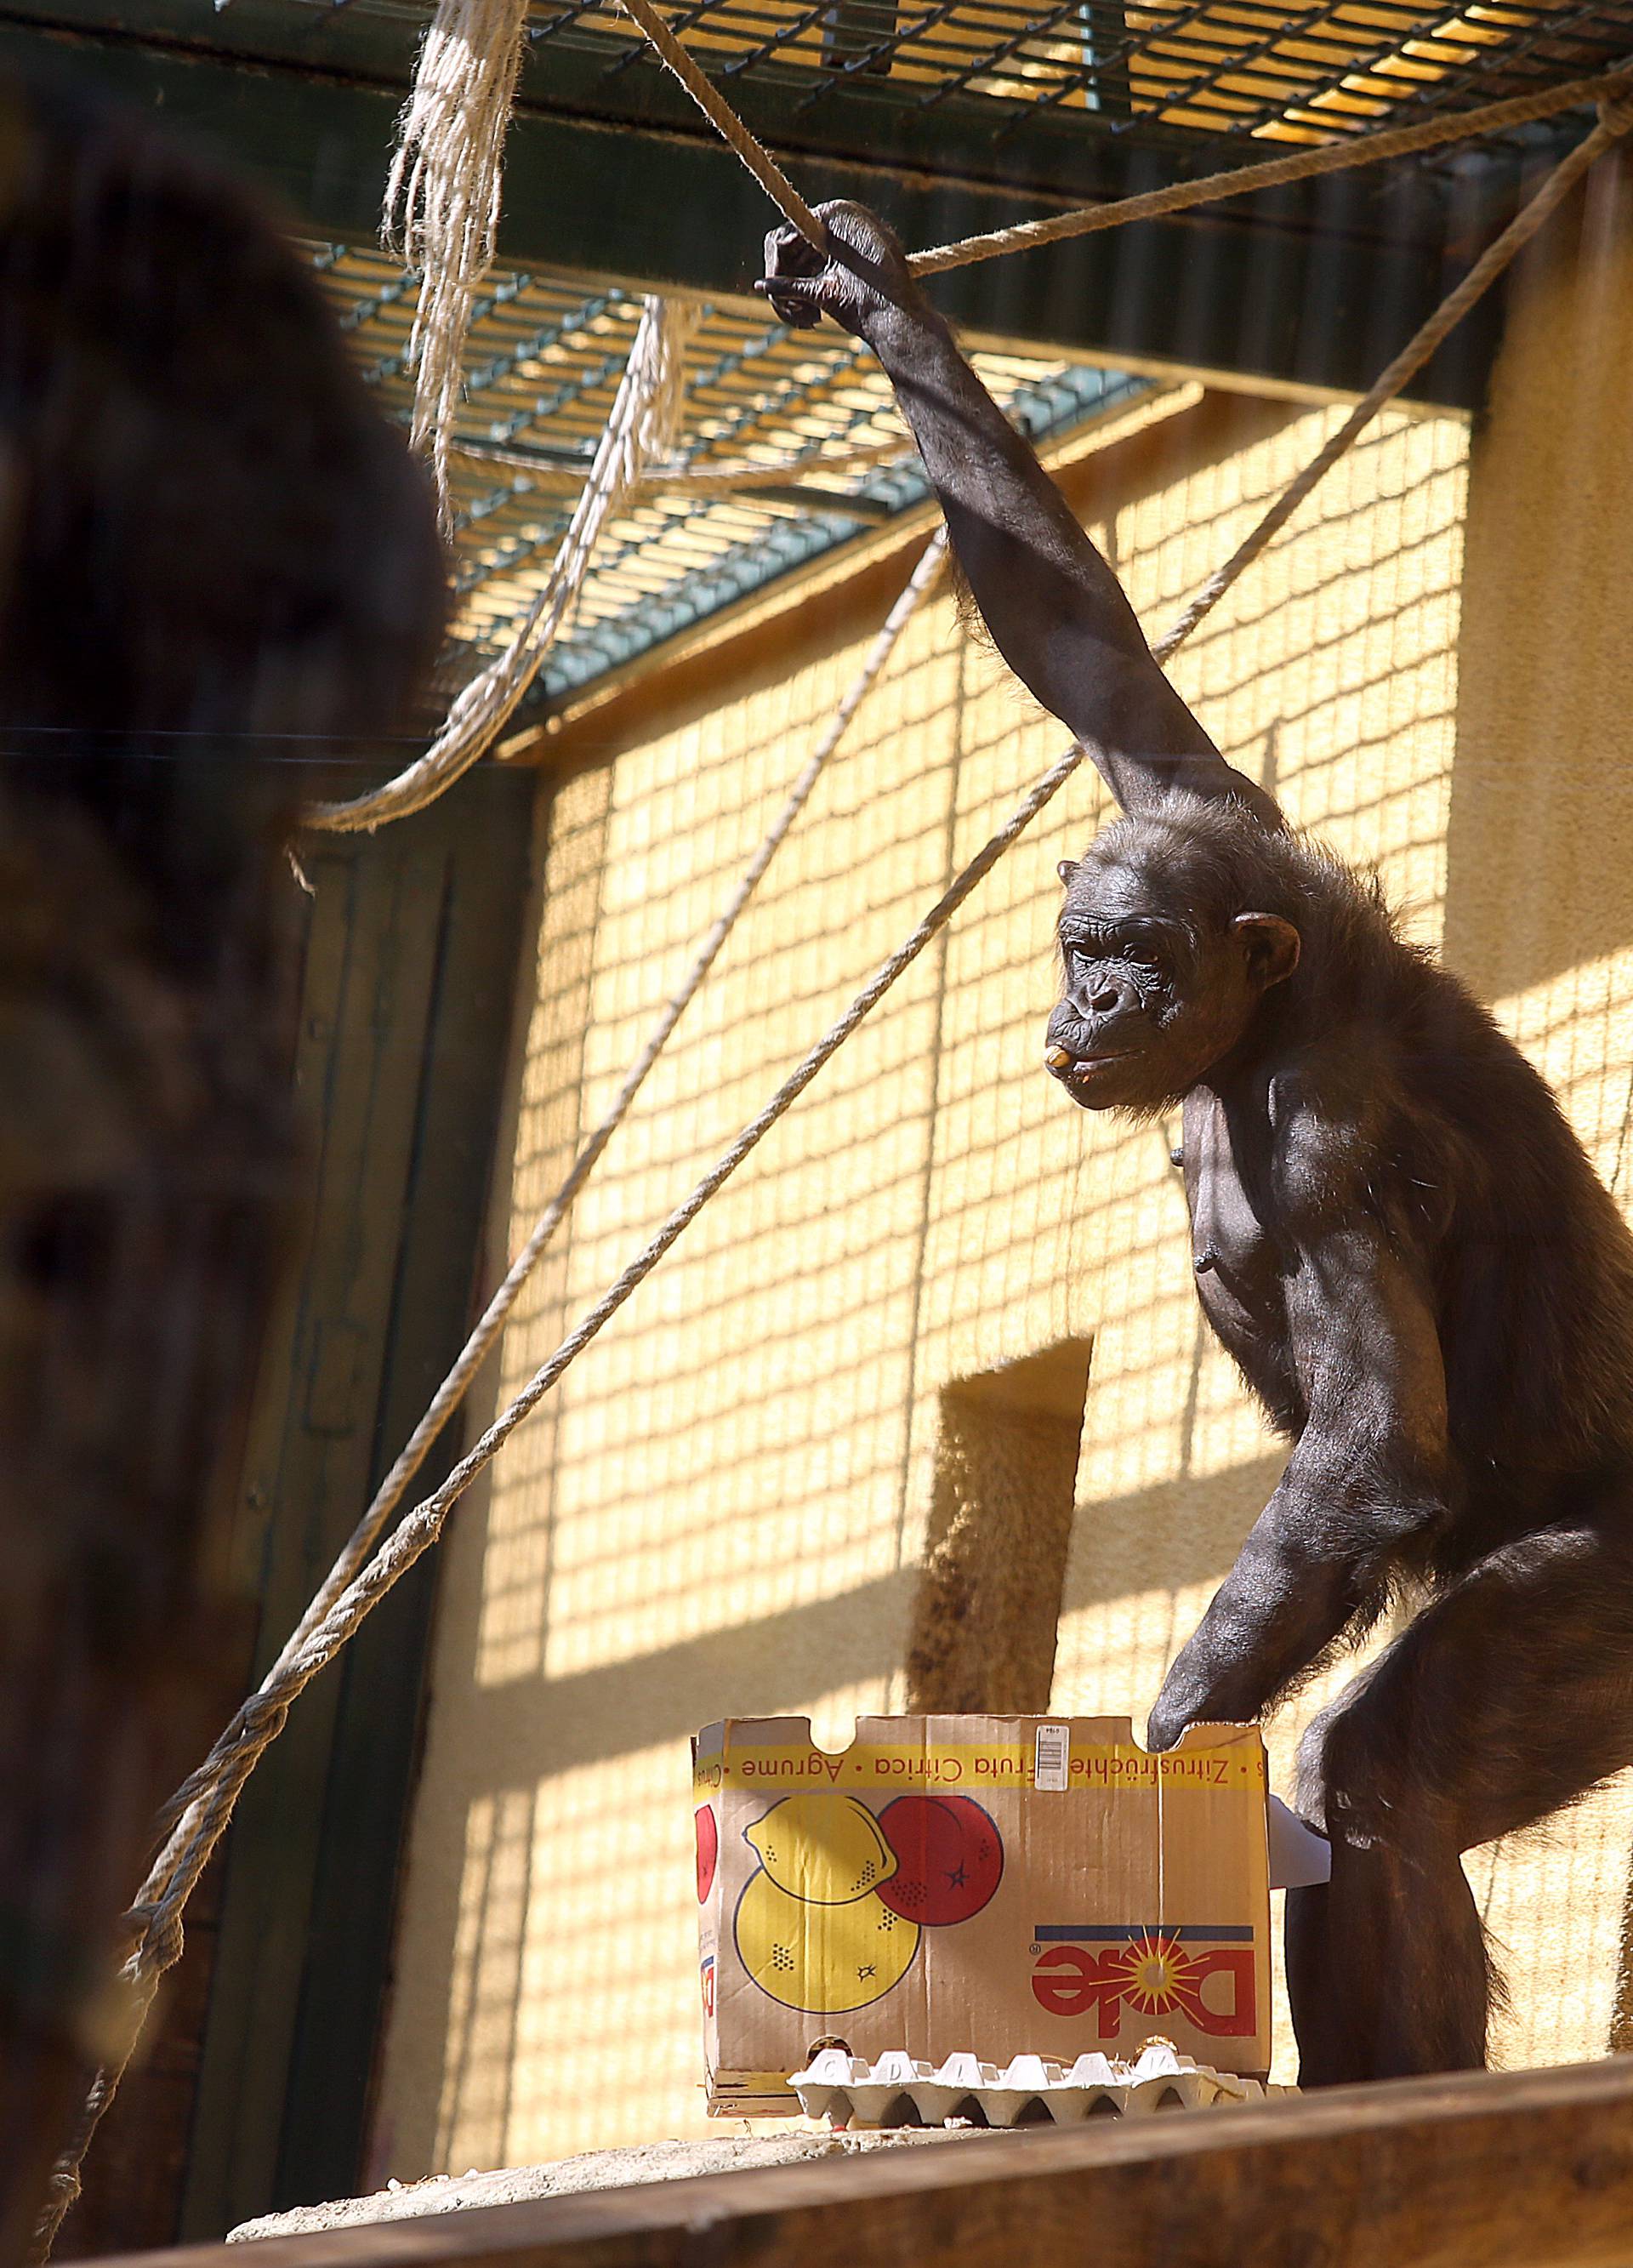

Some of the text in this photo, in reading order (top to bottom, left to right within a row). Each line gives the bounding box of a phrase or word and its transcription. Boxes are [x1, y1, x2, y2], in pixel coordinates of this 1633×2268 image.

[741, 1752, 845, 1783] Agrume
[874, 1758, 963, 1783] Cítrica
[1070, 1757, 1229, 1785] Zitrusfrüchte
[1031, 1936, 1256, 2039] Dole
